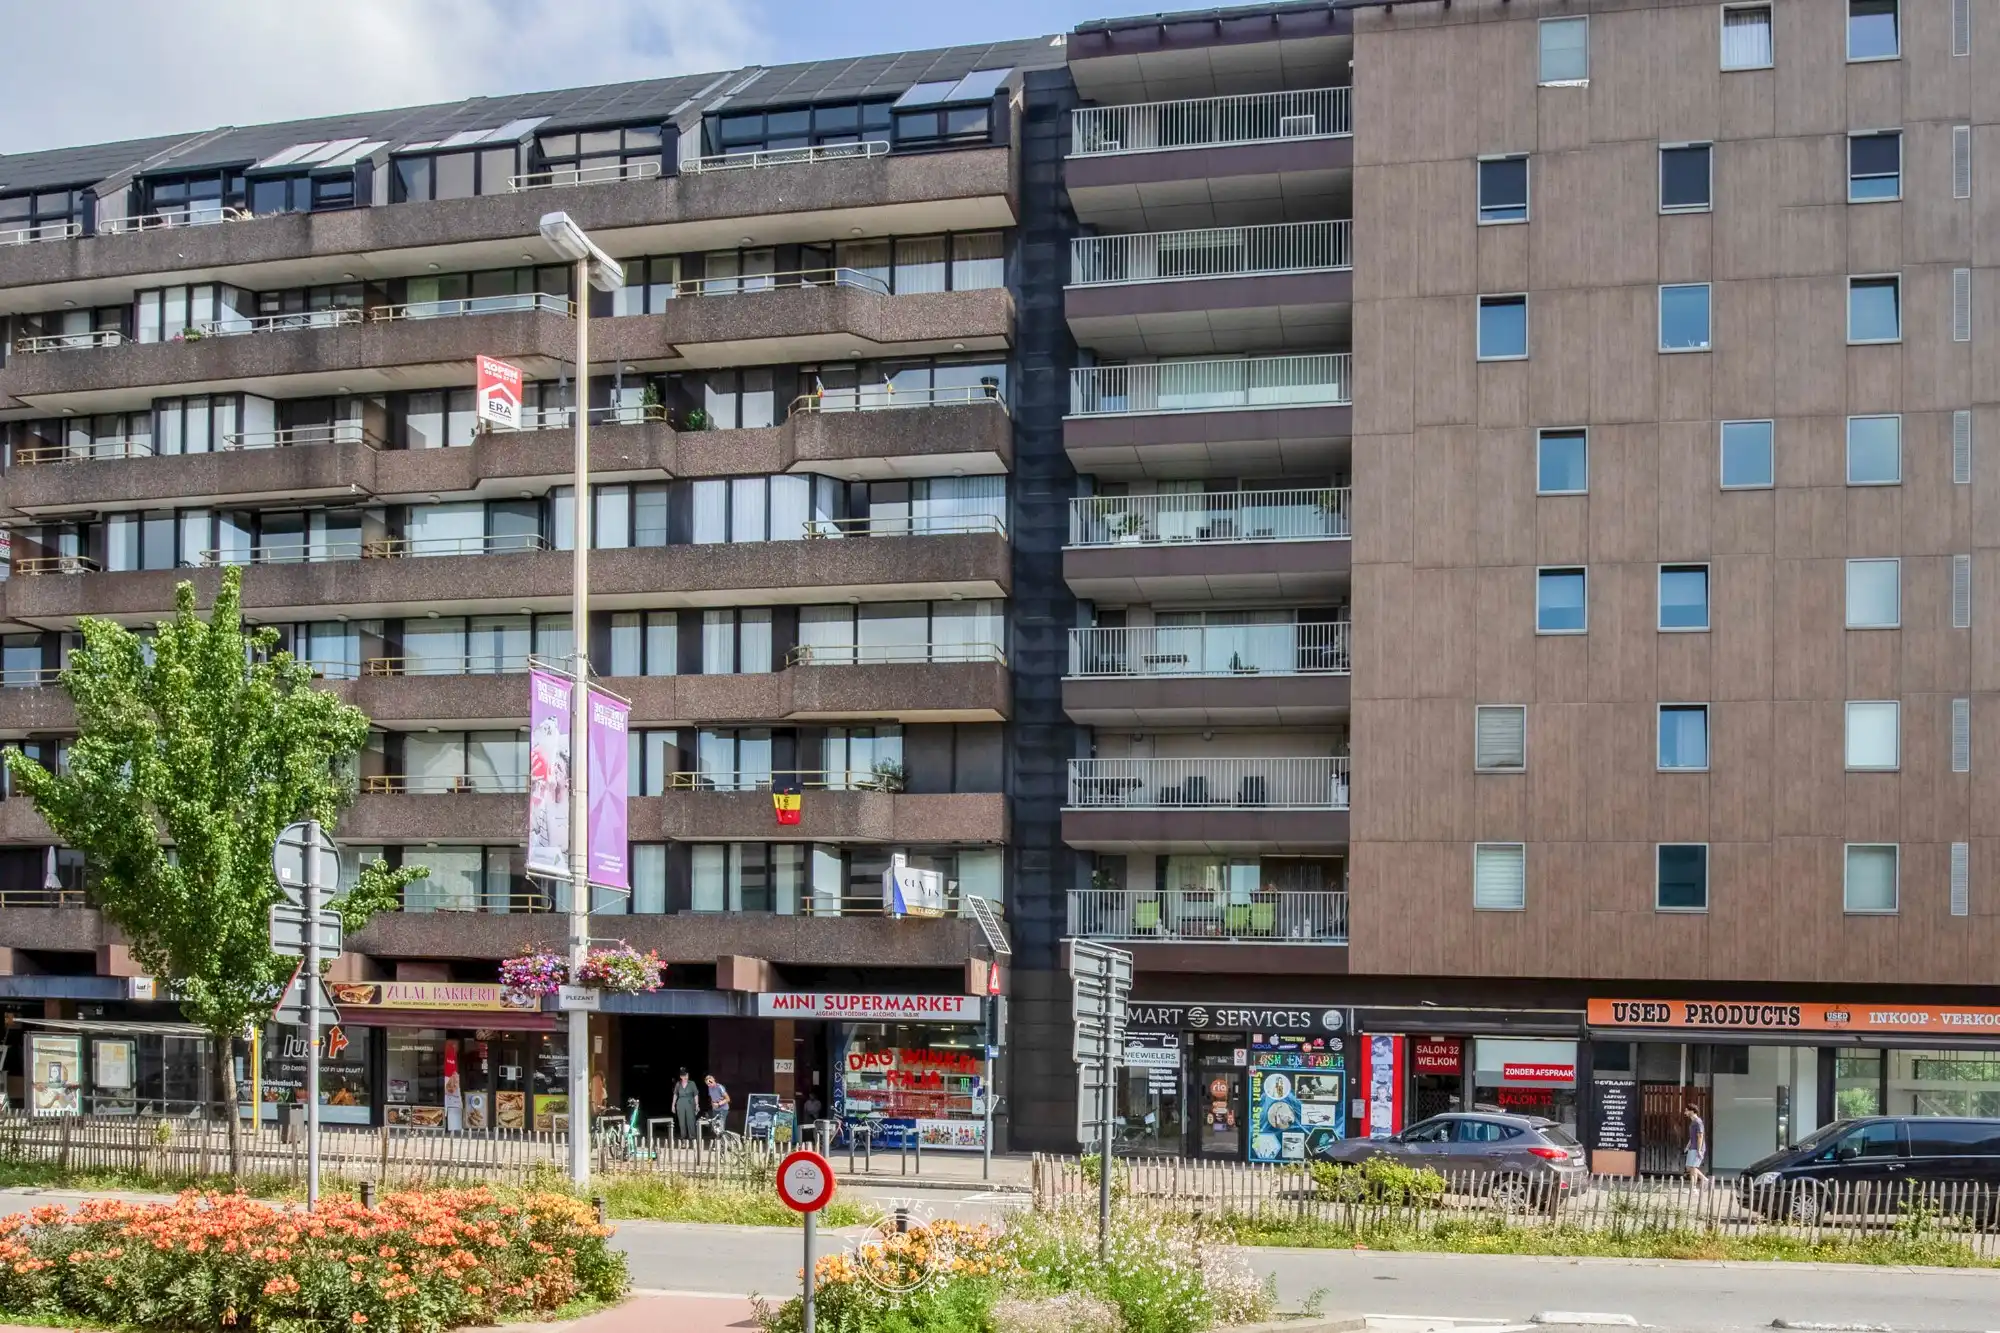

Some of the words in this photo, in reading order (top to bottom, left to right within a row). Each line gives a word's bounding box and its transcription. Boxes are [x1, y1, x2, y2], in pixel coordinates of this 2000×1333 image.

[484, 358, 518, 379] KOPEN
[489, 401, 512, 416] ERA
[773, 995, 816, 1010] MINI
[824, 995, 964, 1012] SUPERMARKET
[1127, 1008, 1183, 1024] MART
[1216, 1009, 1311, 1028] SERVICES
[1612, 1003, 1671, 1023] USED
[1685, 1004, 1801, 1026] PRODUCTS
[1826, 1012, 1848, 1020] USED
[1869, 1012, 1929, 1024] INKOOP
[1125, 1051, 1176, 1060] WEEWIELERS
[1416, 1045, 1447, 1055] SALON
[1449, 1046, 1460, 1055] 32
[848, 1048, 893, 1070] DAG
[1259, 1054, 1283, 1067] GSM
[1287, 1054, 1303, 1067] EN
[1418, 1057, 1457, 1066] WELKOM
[886, 1069, 941, 1088] RAJA
[1505, 1068, 1535, 1076] ZONDER
[1535, 1068, 1574, 1077] AFSPRAAK
[1212, 1082, 1227, 1091] ria
[1252, 1072, 1263, 1102] Smart
[1498, 1095, 1537, 1105] SALON
